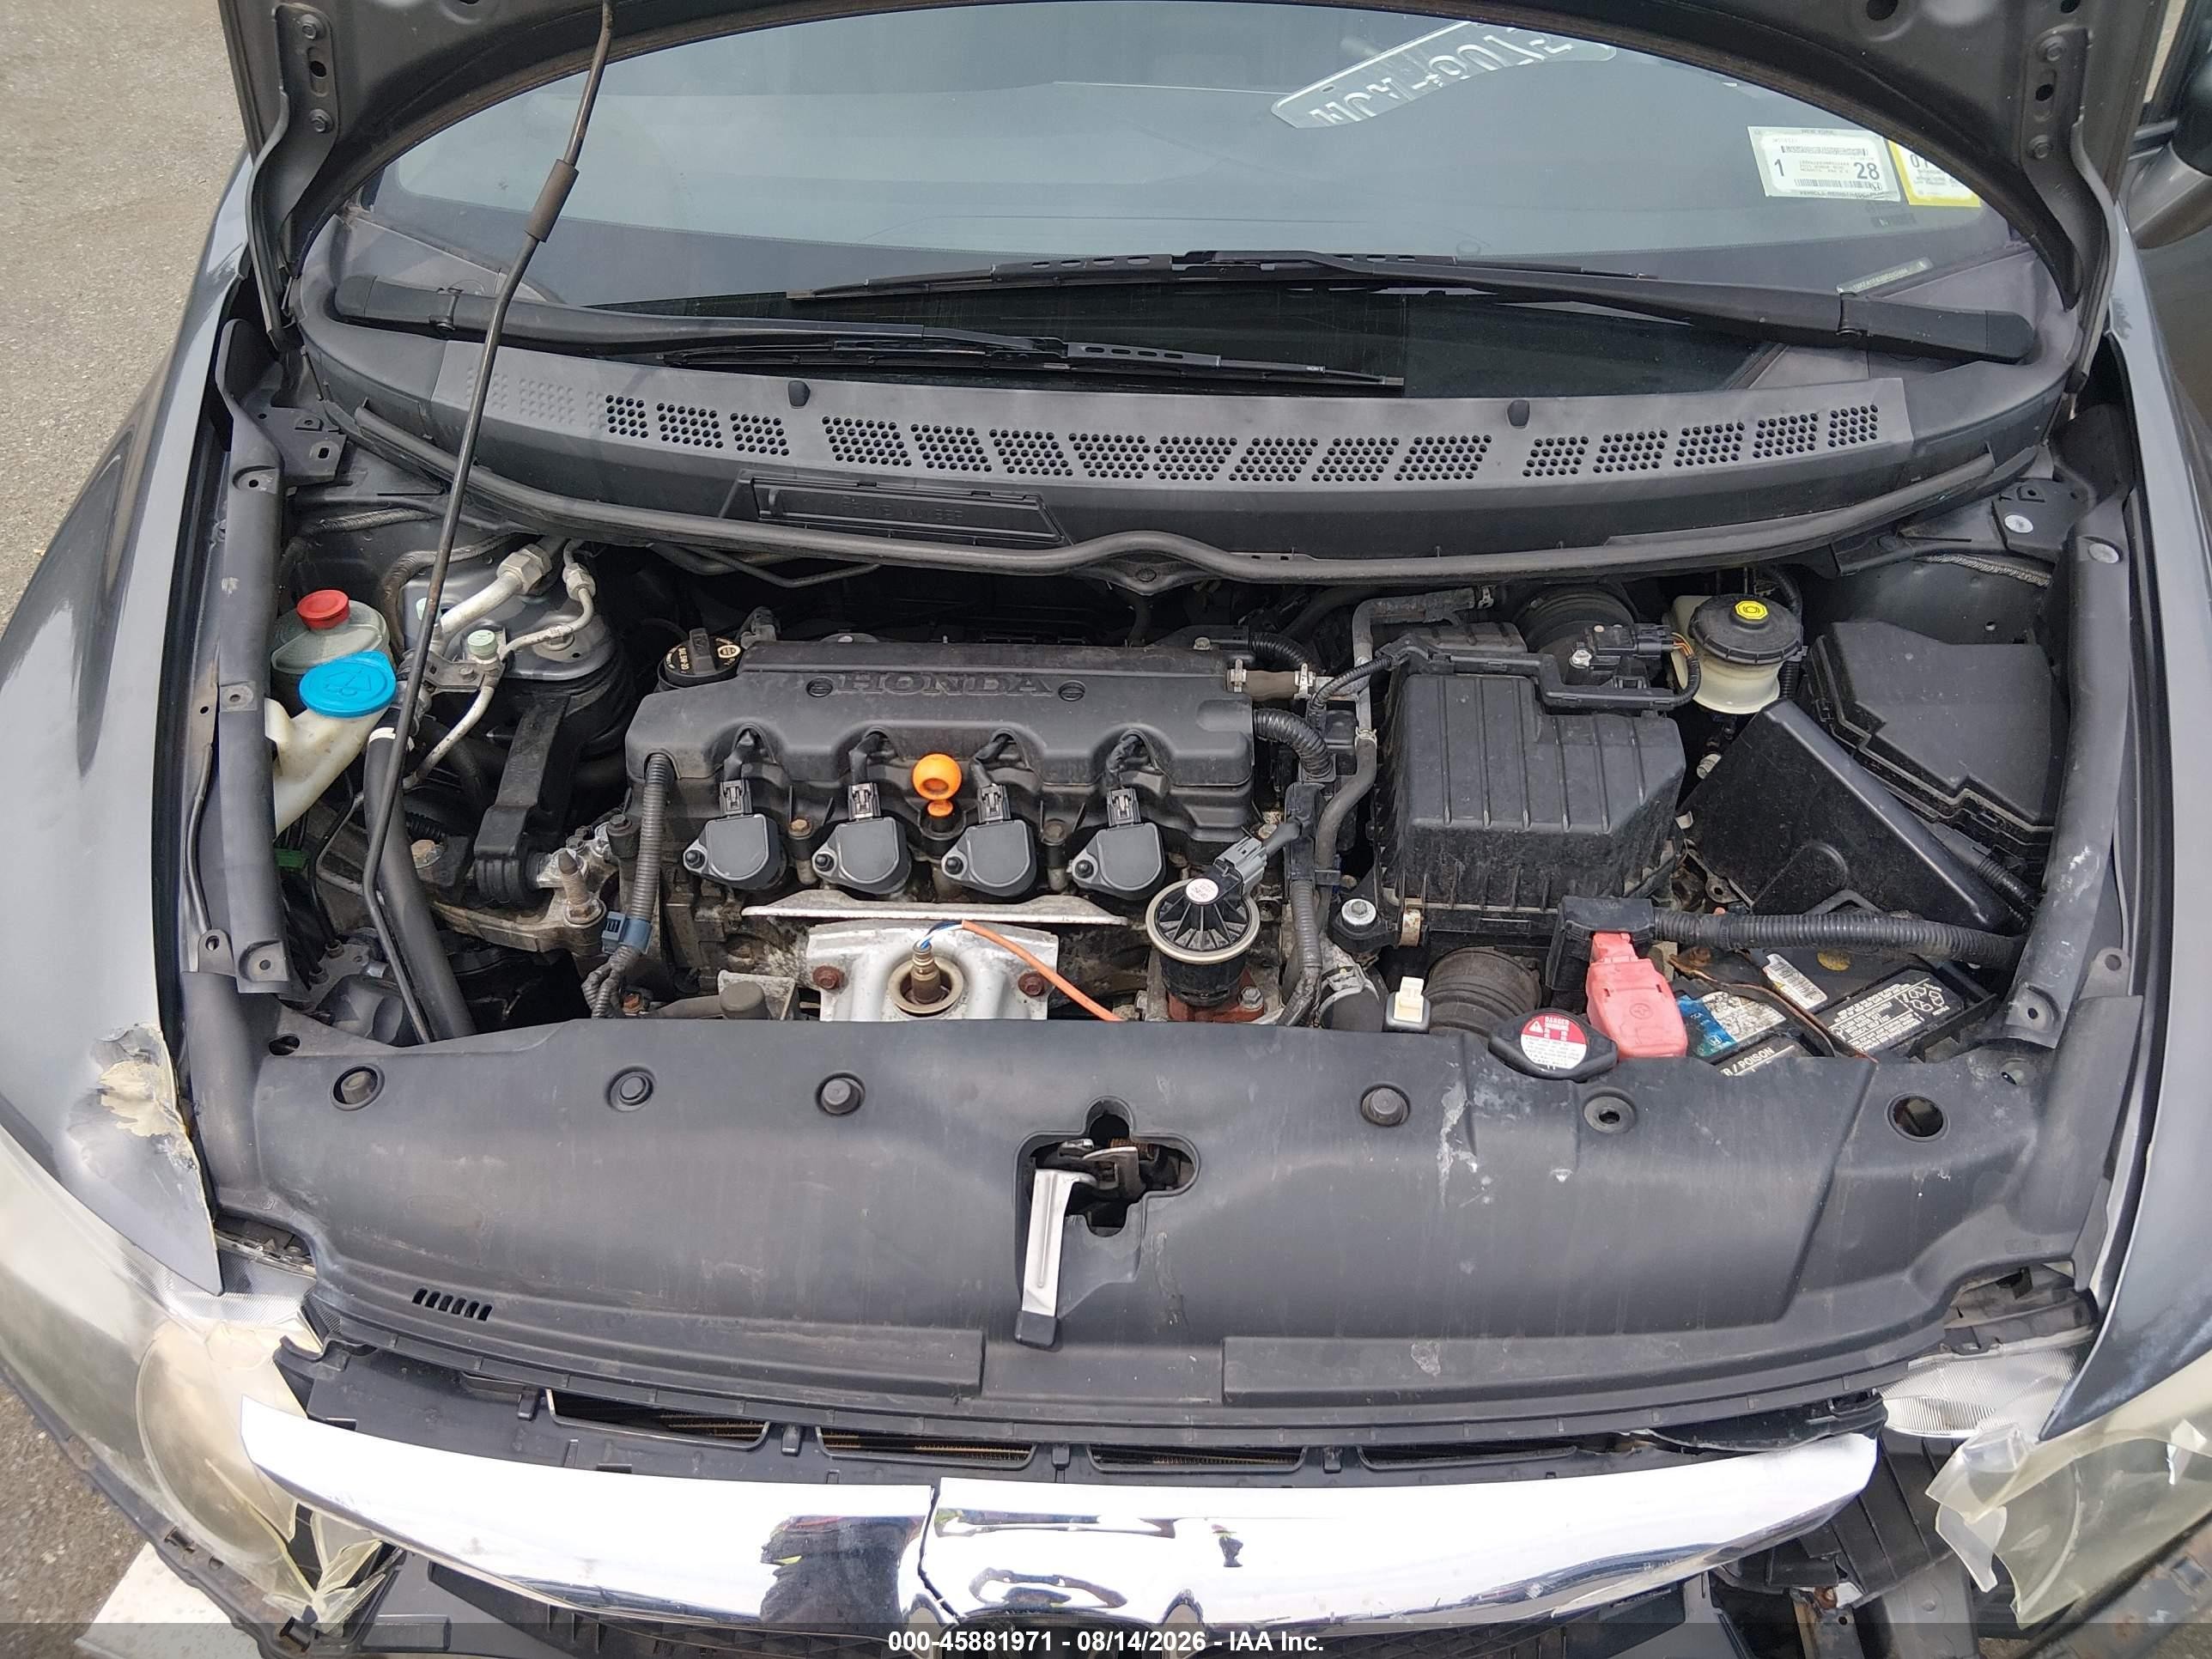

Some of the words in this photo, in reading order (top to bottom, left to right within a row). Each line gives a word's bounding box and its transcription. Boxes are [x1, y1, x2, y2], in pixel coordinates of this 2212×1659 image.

[1774, 159, 1784, 177] 1
[1853, 161, 1880, 180] 28
[836, 672, 1054, 696] HONDA
[1738, 1047, 1775, 1069] POISON
